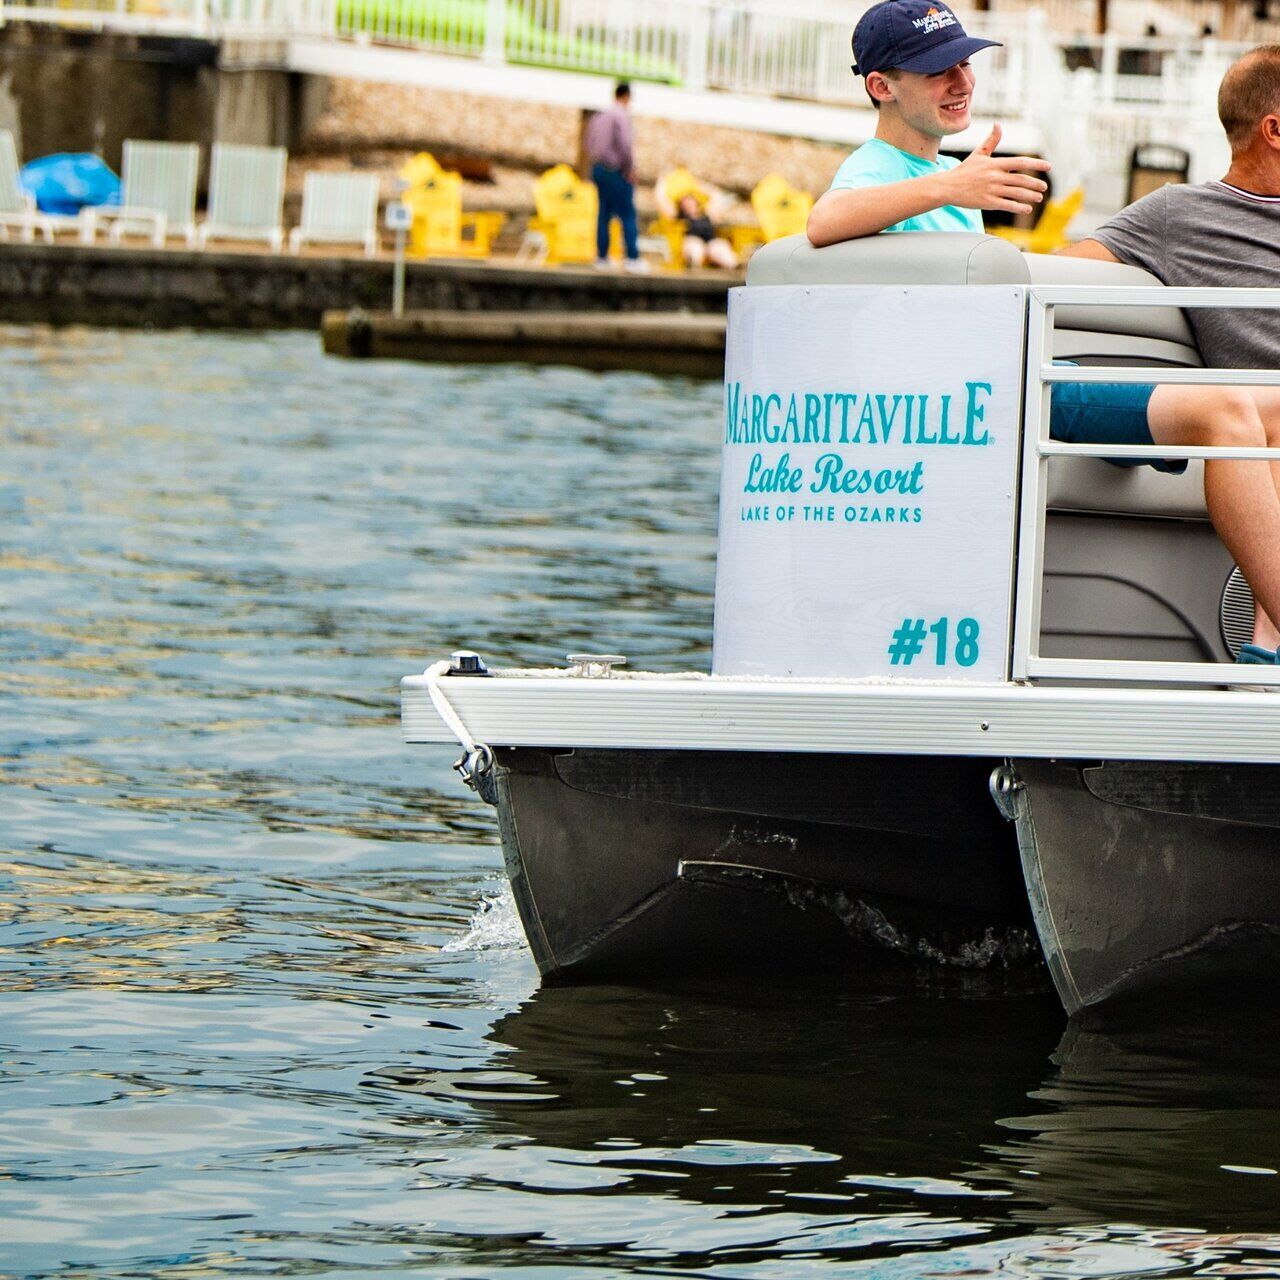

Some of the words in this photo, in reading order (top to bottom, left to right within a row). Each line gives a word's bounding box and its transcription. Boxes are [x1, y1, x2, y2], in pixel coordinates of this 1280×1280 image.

[725, 381, 992, 446] MARGARITAVILLE
[744, 453, 803, 493] Lake
[810, 453, 923, 495] Resort
[741, 506, 769, 521] LAKE
[776, 506, 795, 521] OF
[803, 506, 835, 521] THE
[844, 507, 922, 523] OZARKS
[887, 617, 980, 667] #18
